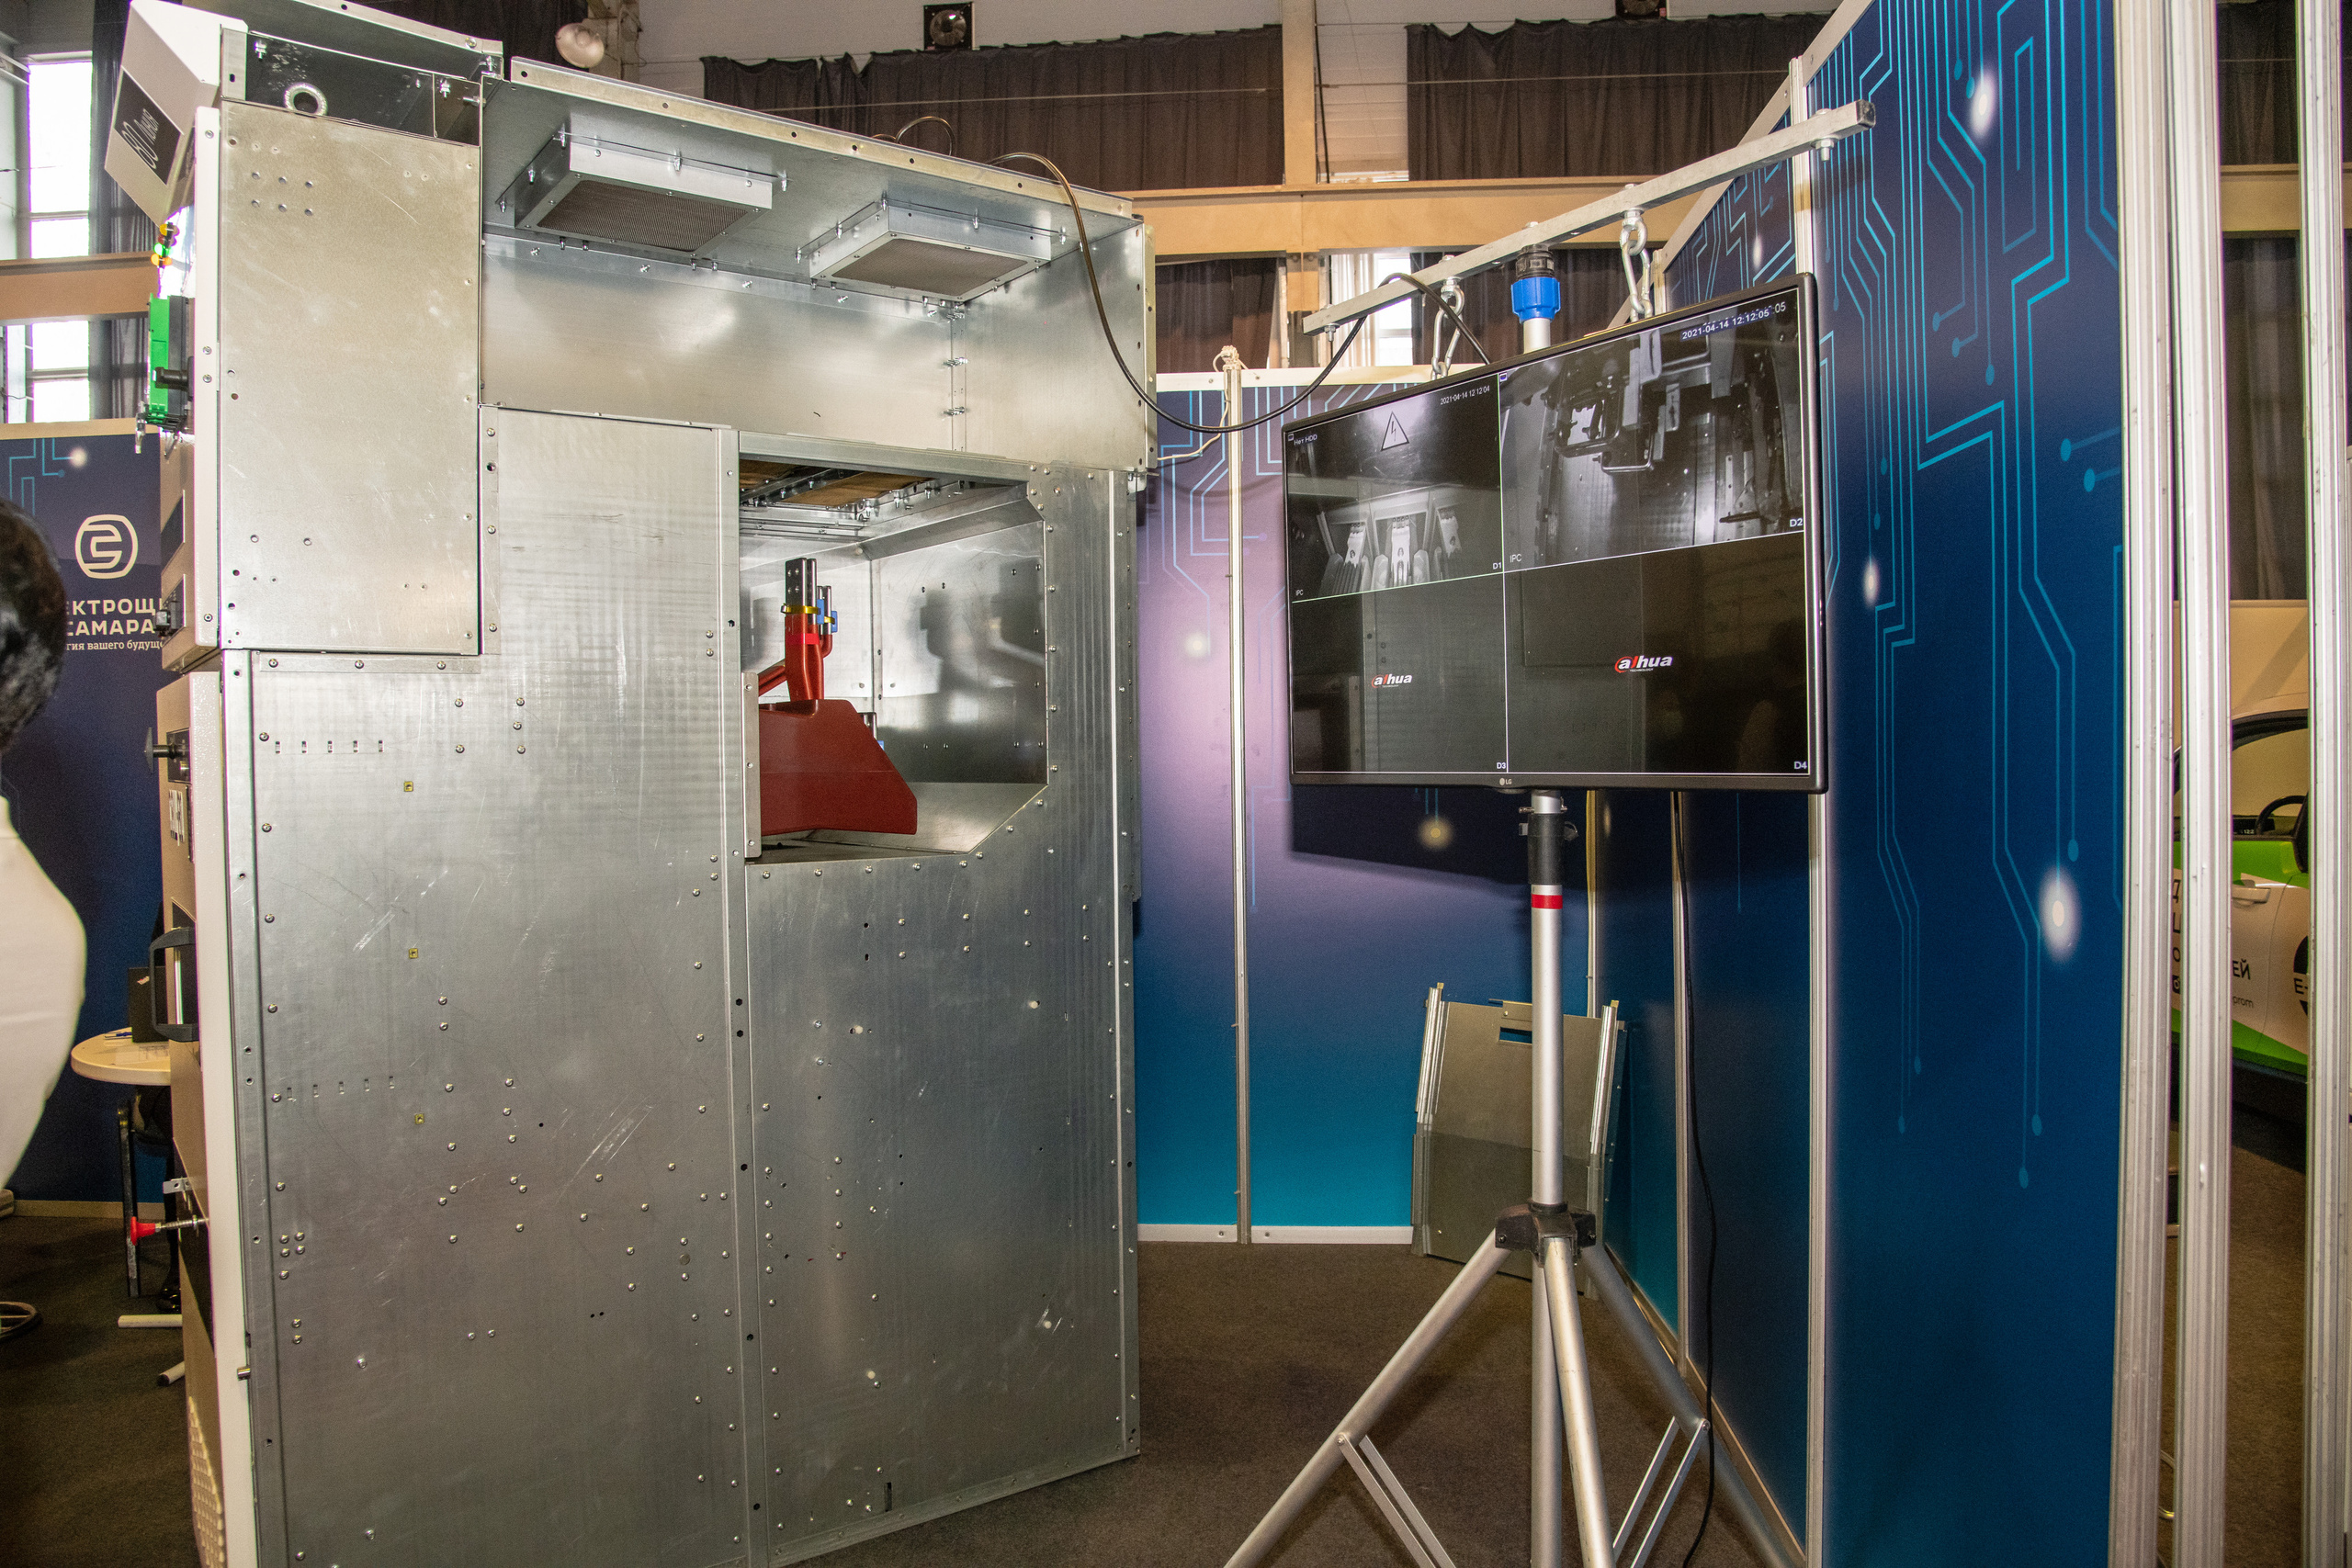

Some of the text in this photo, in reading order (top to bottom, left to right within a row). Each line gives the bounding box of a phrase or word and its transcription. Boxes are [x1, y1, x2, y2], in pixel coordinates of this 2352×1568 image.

[121, 121, 159, 170] 80
[1682, 309, 1770, 340] 2021-04-14 12:12:05
[1440, 392, 1468, 405] 2021-04-14
[1789, 517, 1804, 527] D2
[1510, 554, 1522, 563] IPC
[87, 641, 125, 650] вашего
[1496, 761, 1507, 770] D3
[1793, 761, 1808, 770] D4
